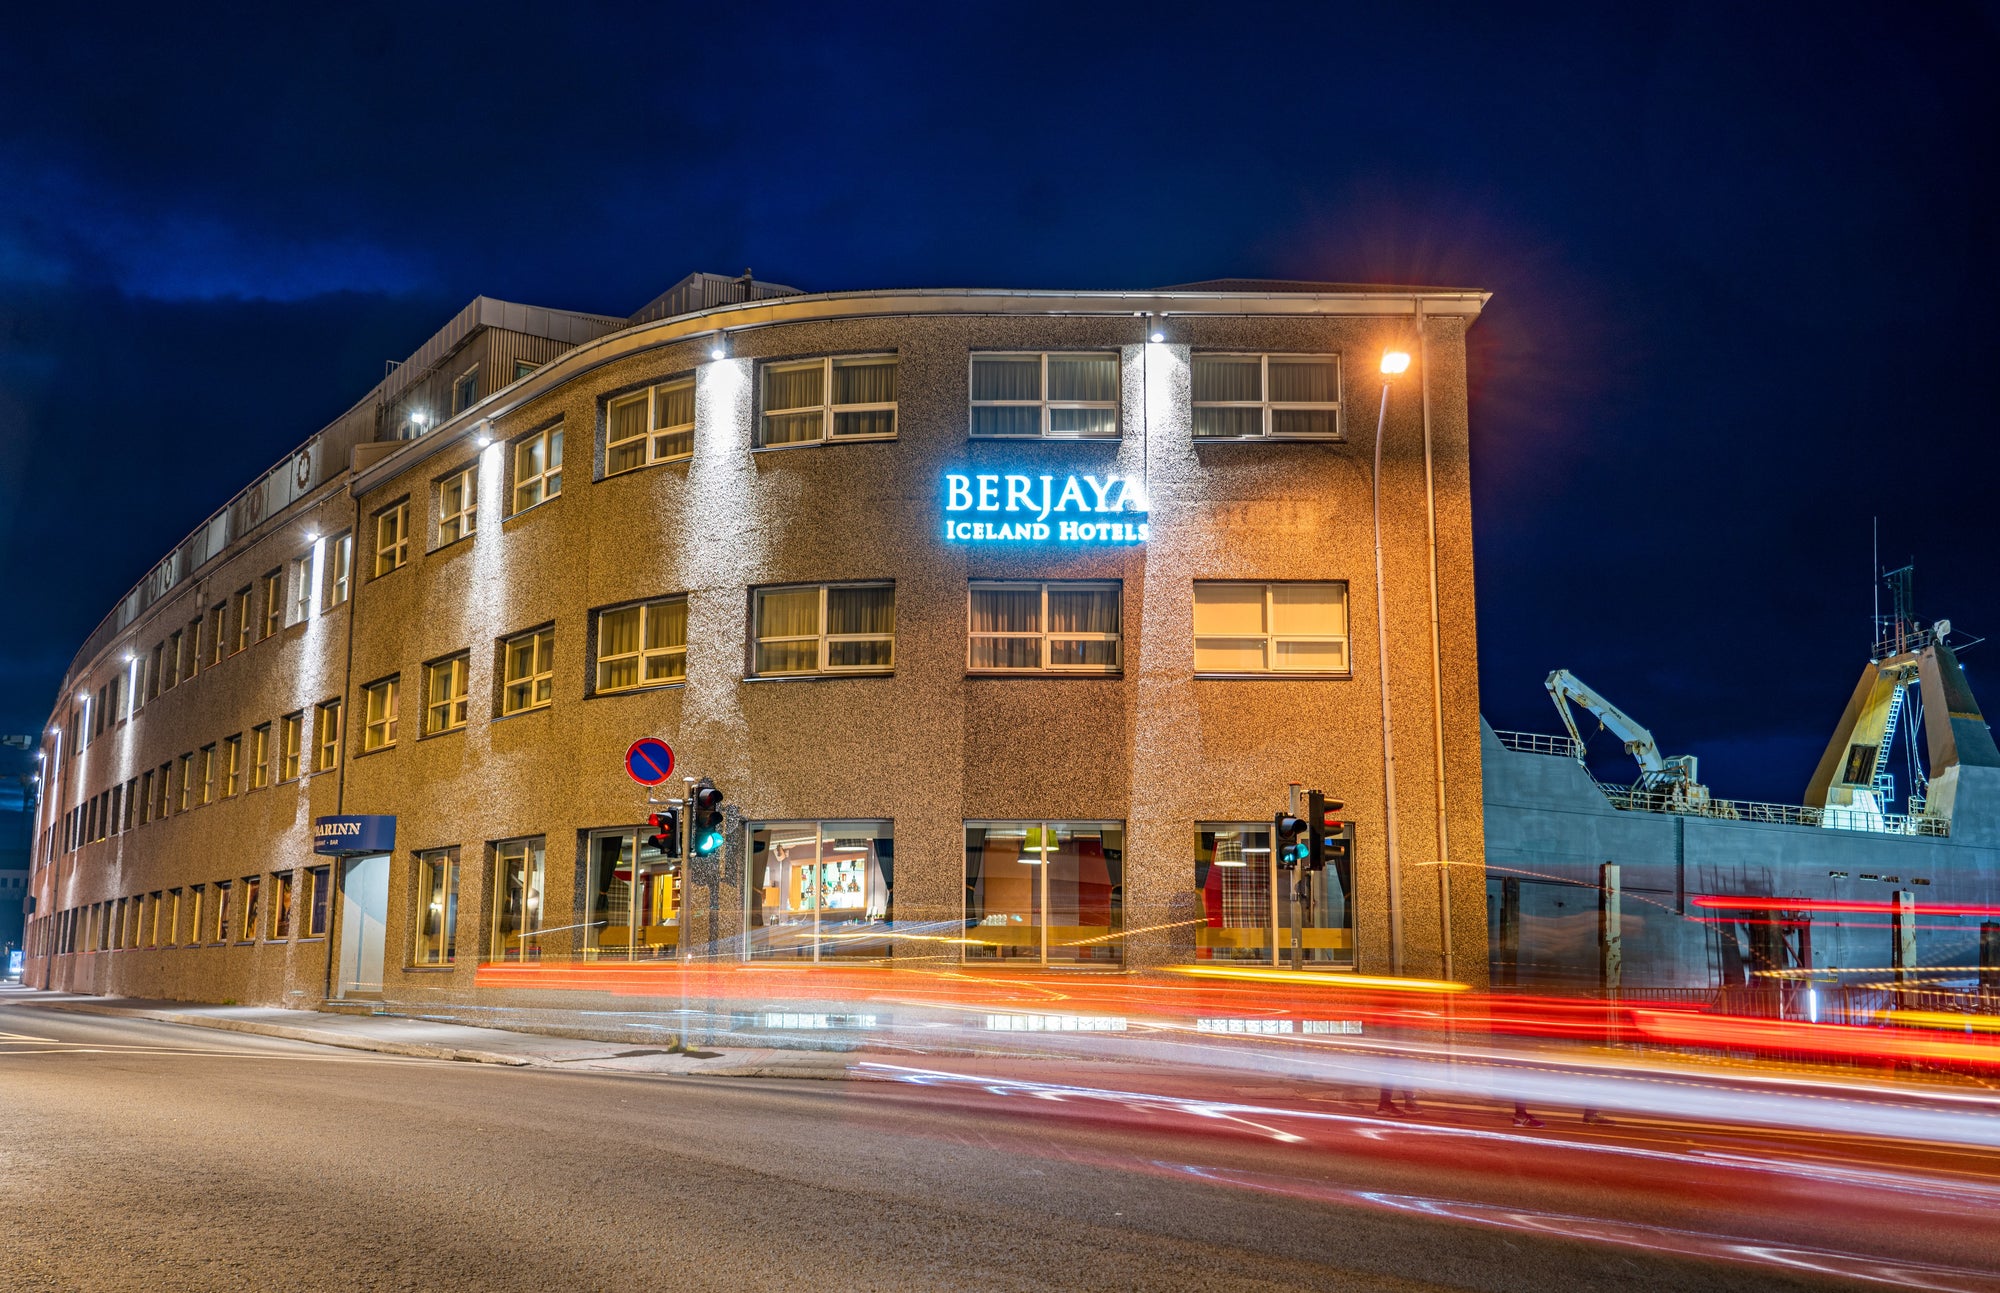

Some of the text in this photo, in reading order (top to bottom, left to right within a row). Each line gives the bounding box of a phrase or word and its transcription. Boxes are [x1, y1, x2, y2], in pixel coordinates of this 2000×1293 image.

[946, 474, 1149, 522] BERJAYA
[946, 521, 1150, 540] ICELAND HOTELS
